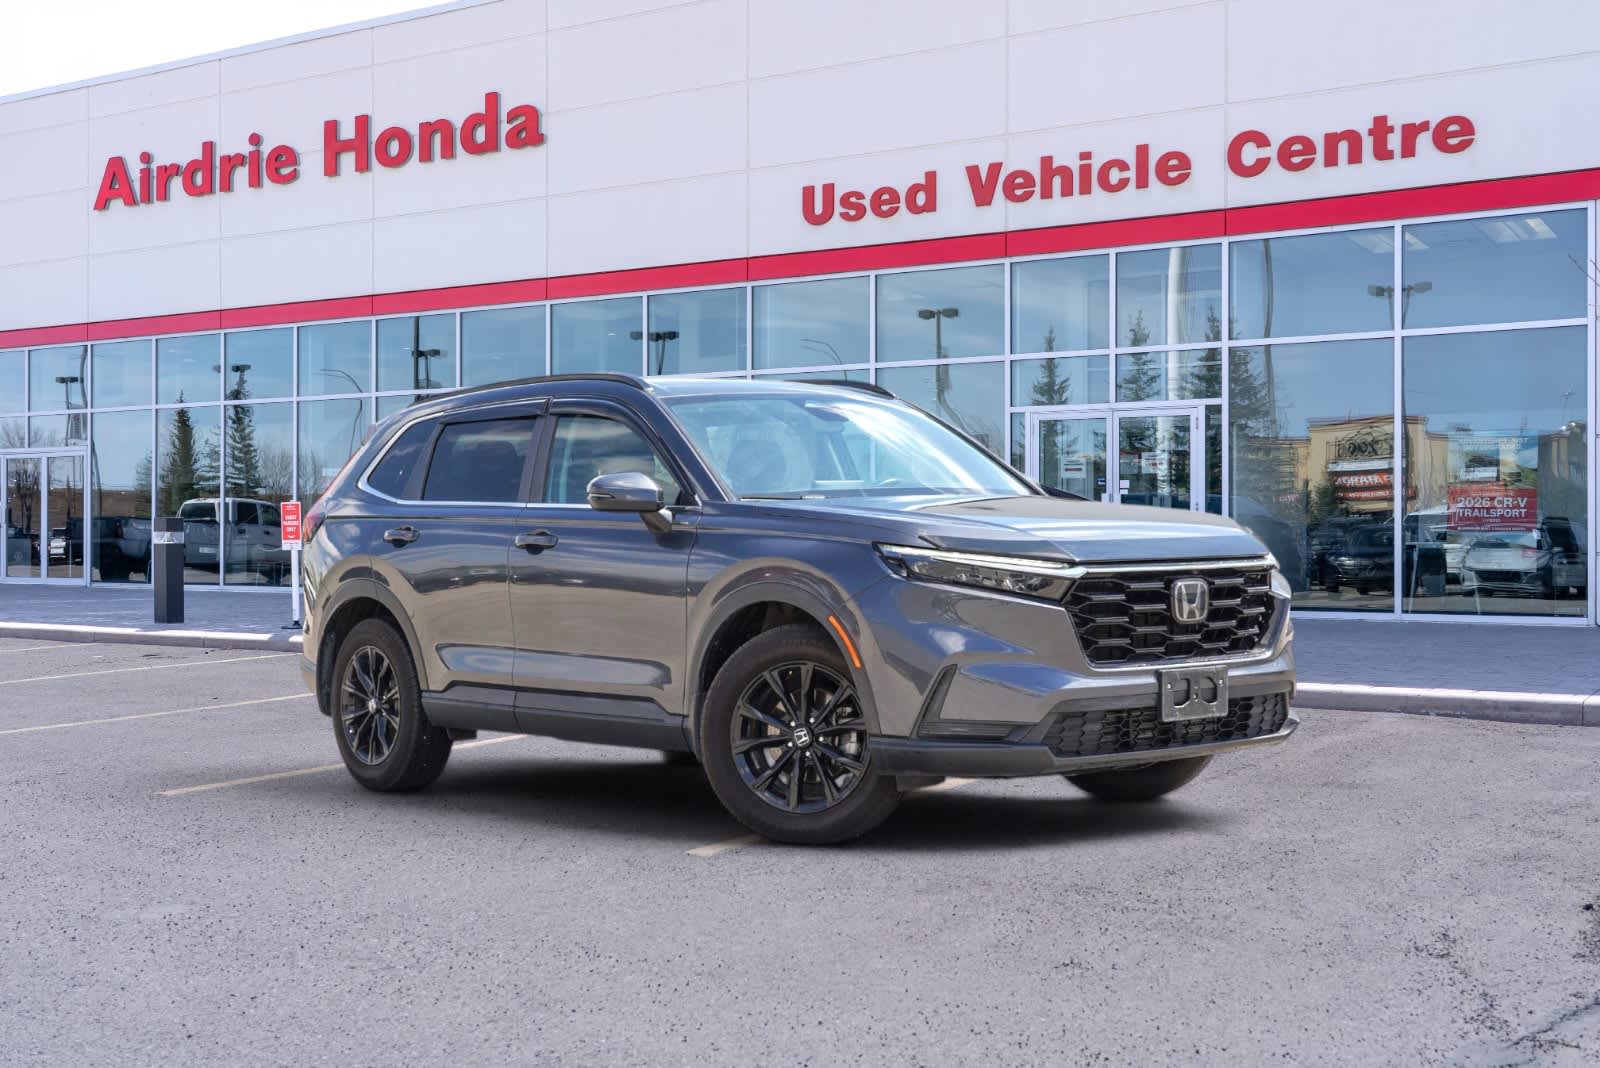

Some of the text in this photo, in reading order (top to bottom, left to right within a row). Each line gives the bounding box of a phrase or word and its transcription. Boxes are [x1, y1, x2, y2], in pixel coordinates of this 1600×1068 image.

[94, 92, 544, 210] Airdrie Honda
[802, 116, 1475, 224] Used Vehicle Centre
[1457, 497, 1527, 508] 2026 CR-V
[1458, 509, 1528, 518] TRAILSPORT
